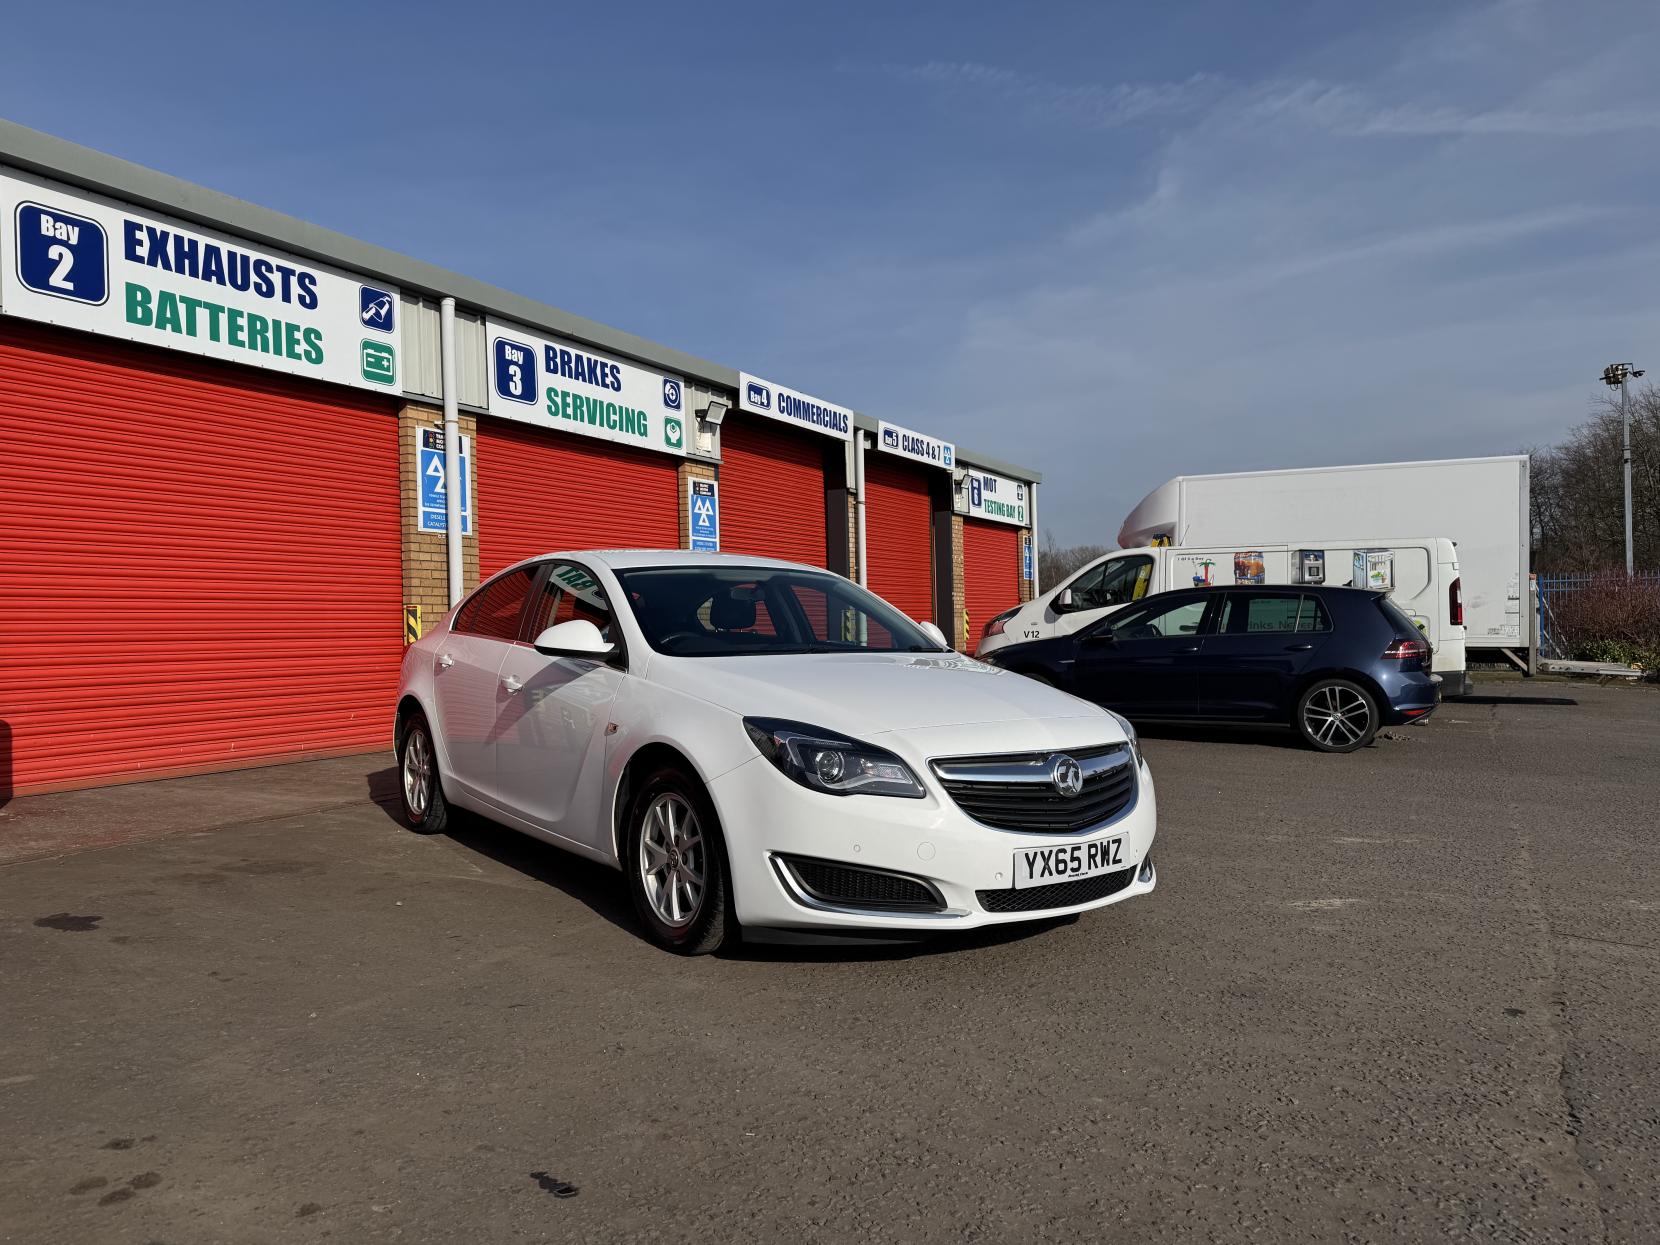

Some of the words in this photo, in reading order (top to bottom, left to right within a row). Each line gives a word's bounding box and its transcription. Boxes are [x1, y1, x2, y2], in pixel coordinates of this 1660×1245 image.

[40, 213, 80, 245] Bay
[47, 244, 75, 291] 2
[123, 218, 319, 311] EXHAUSTS
[125, 281, 325, 366] BATTERIES
[504, 344, 524, 365] Bay
[544, 344, 622, 393] BRAKES
[509, 366, 522, 396] 3
[546, 386, 648, 438] SERVICING
[750, 390, 762, 405] Bay
[761, 389, 768, 406] 4
[777, 392, 848, 433] COMMERCIALS
[892, 432, 898, 447] 5
[902, 434, 925, 457] CLASS
[925, 442, 930, 458] 4
[931, 446, 937, 460] &
[937, 445, 941, 461] 7
[983, 476, 996, 493] MOT
[984, 499, 1005, 517] TESTING
[1006, 504, 1016, 518] BAY
[1024, 845, 1082, 880] YX65
[1088, 837, 1122, 870] RWZ
